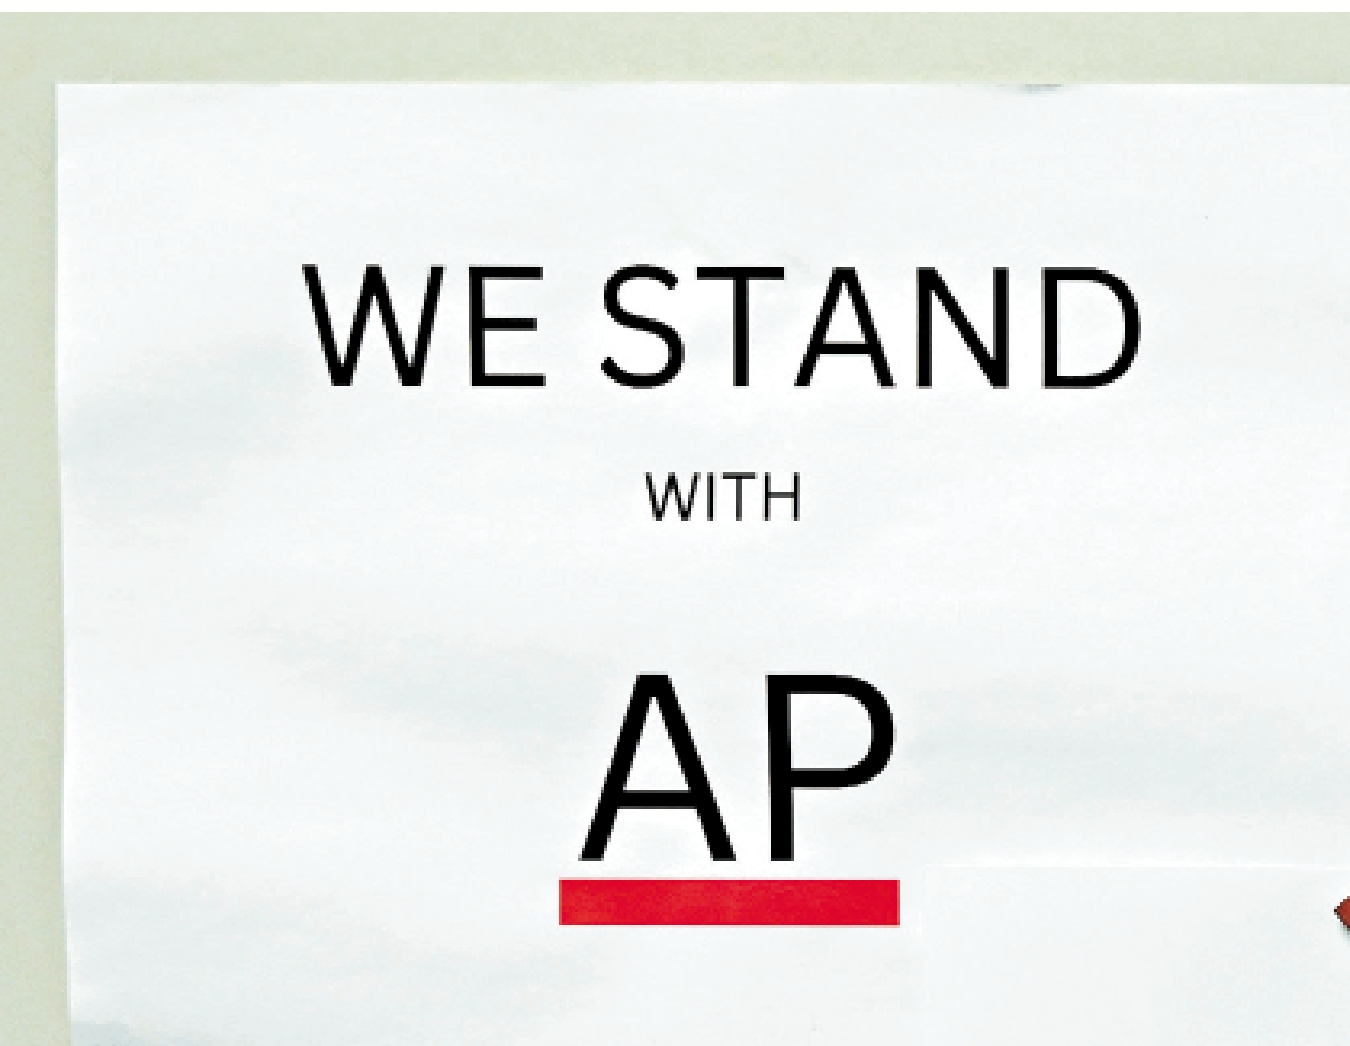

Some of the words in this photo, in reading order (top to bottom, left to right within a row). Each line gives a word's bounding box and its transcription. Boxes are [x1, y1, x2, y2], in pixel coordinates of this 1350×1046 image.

[302, 264, 546, 388] WE
[601, 264, 1142, 390] STAND
[645, 471, 801, 522] WITH
[581, 674, 895, 862] AP
